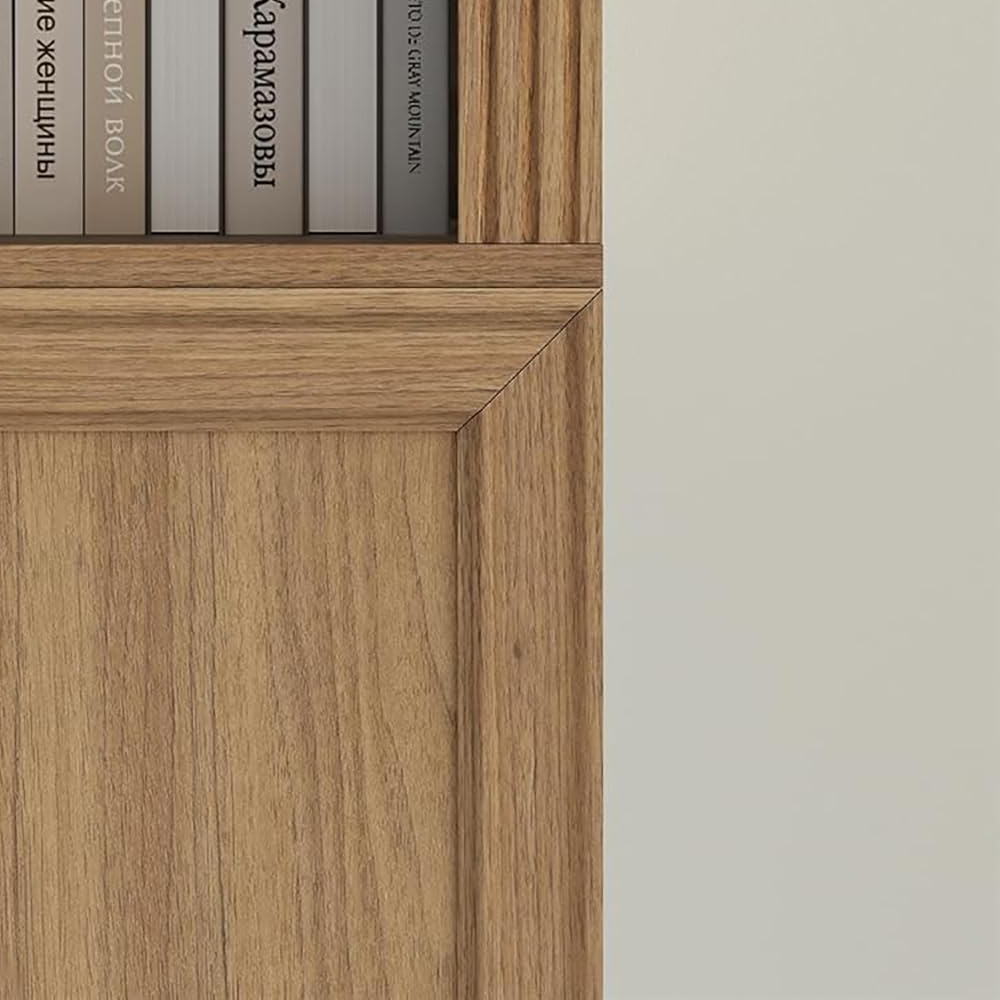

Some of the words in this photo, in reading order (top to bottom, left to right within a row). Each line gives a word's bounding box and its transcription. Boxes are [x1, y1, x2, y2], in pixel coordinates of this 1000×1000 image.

[407, 50, 422, 88] GRAY
[33, 39, 56, 180] женщины
[407, 92, 422, 175] MOUNTAIN
[104, 118, 126, 194] волк
